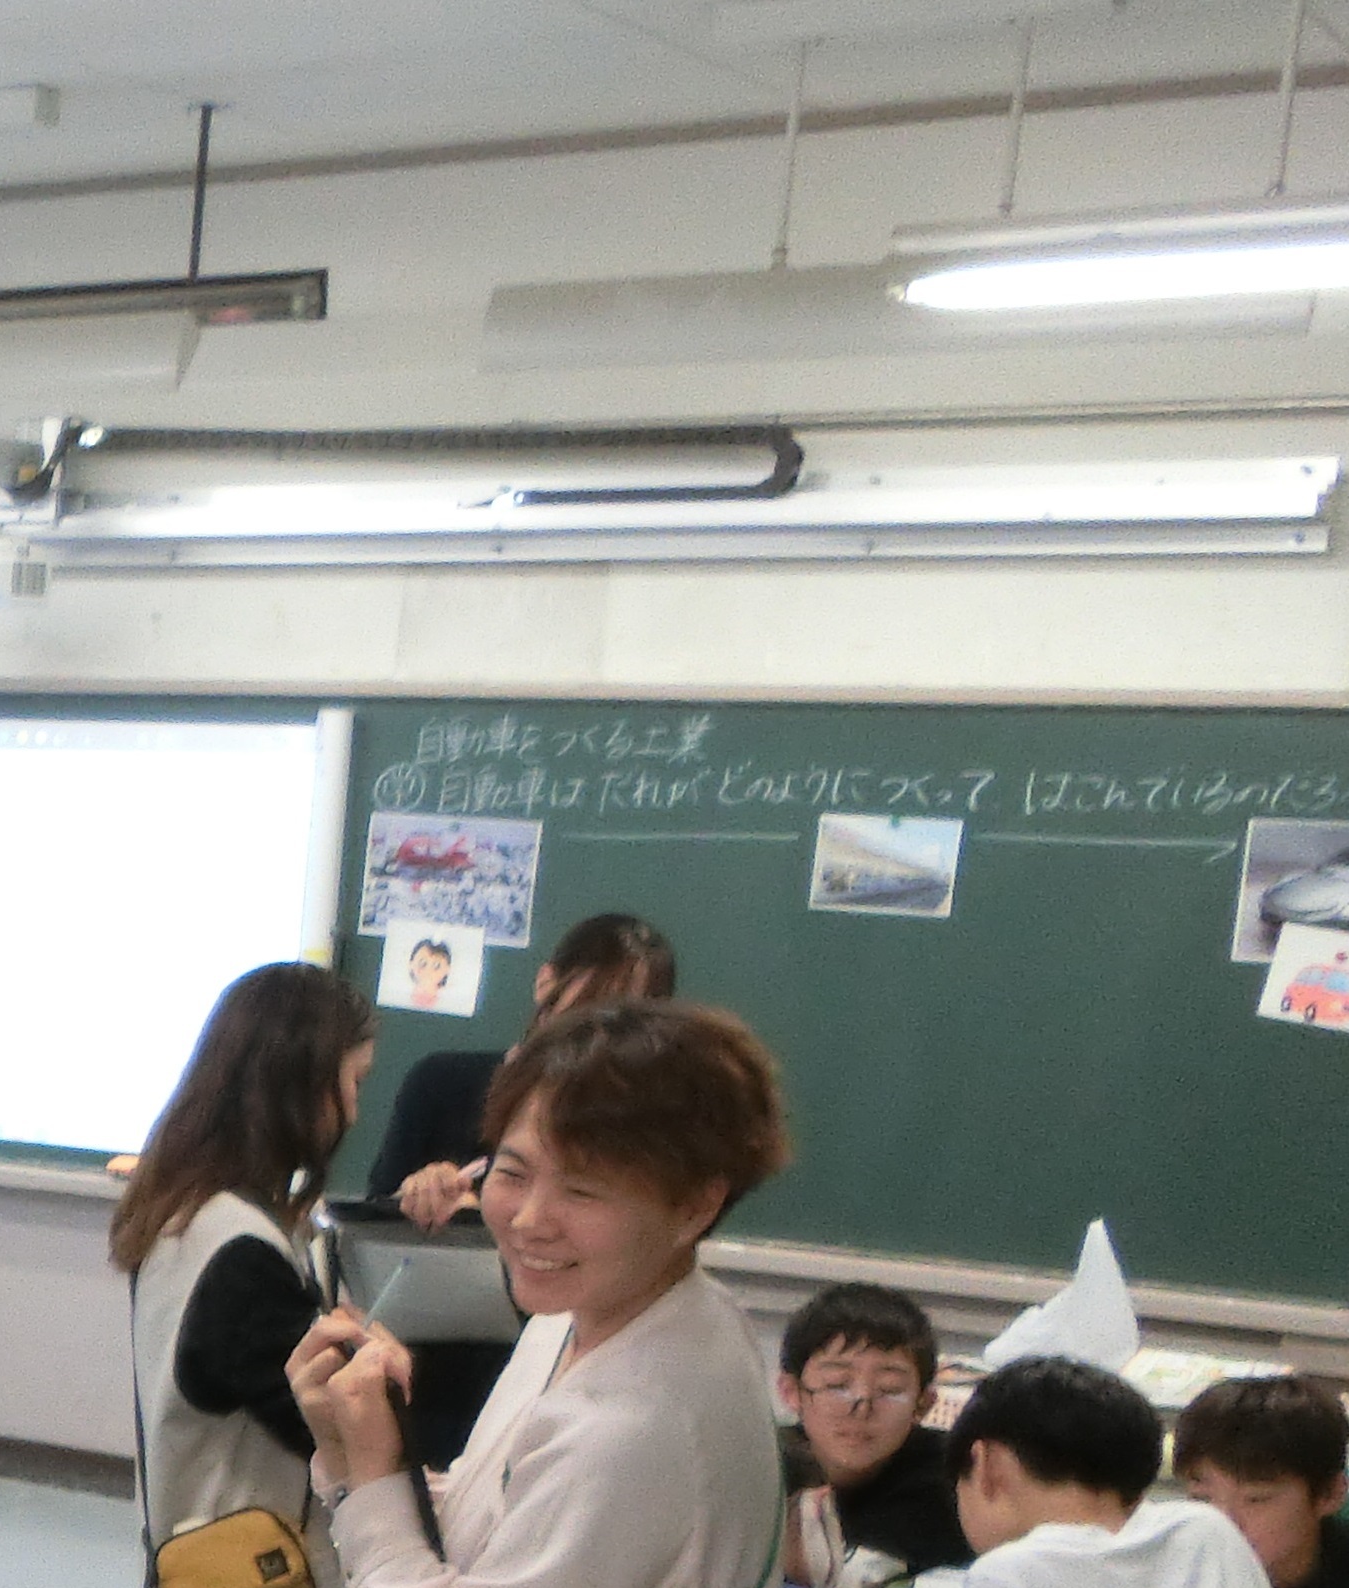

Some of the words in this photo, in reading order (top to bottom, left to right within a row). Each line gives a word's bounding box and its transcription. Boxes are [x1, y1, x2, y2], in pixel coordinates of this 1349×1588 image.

[416, 713, 713, 765] 自動車をつくる工業
